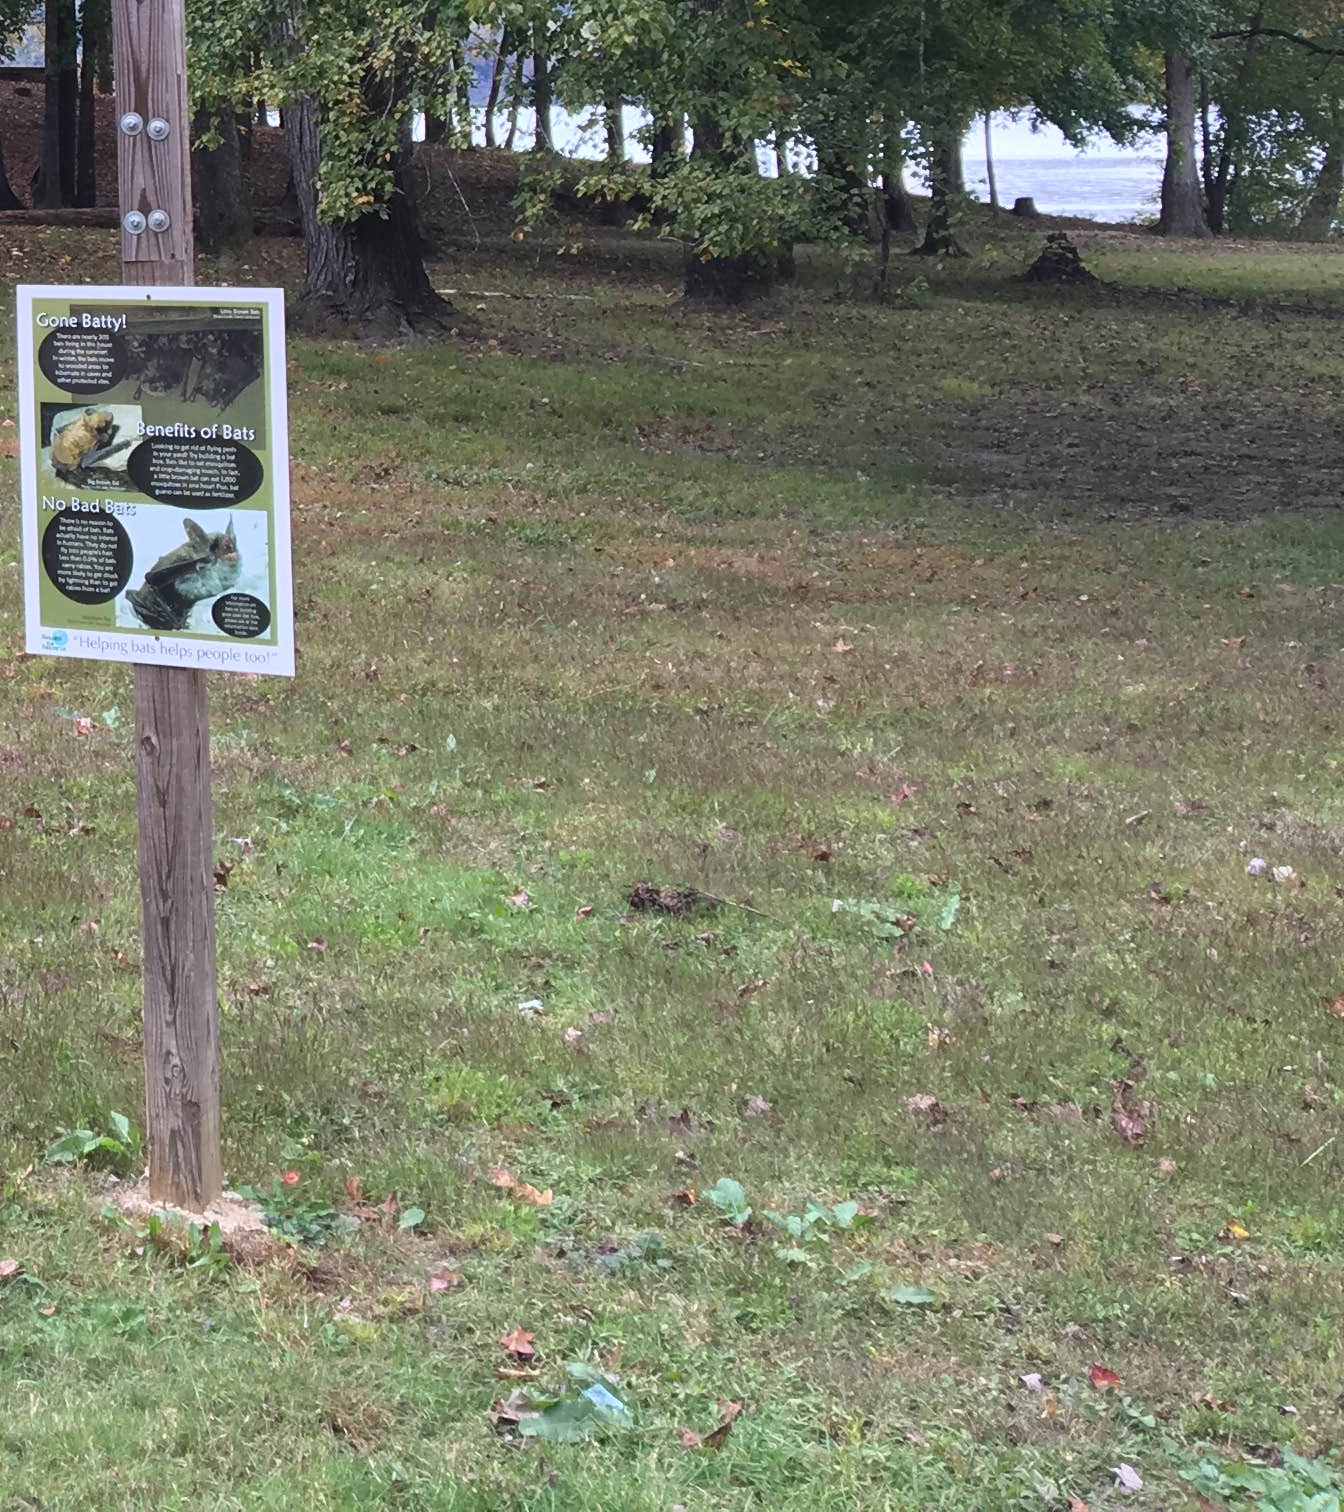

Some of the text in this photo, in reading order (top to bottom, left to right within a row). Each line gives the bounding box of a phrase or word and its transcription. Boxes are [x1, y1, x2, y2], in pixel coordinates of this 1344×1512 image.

[36, 312, 127, 332] Gone Batty!
[137, 421, 255, 441] Benefits of Bats
[42, 495, 137, 516] No Bad Bats
[132, 639, 156, 654] bats
[160, 642, 193, 660] helps
[197, 648, 241, 664] people
